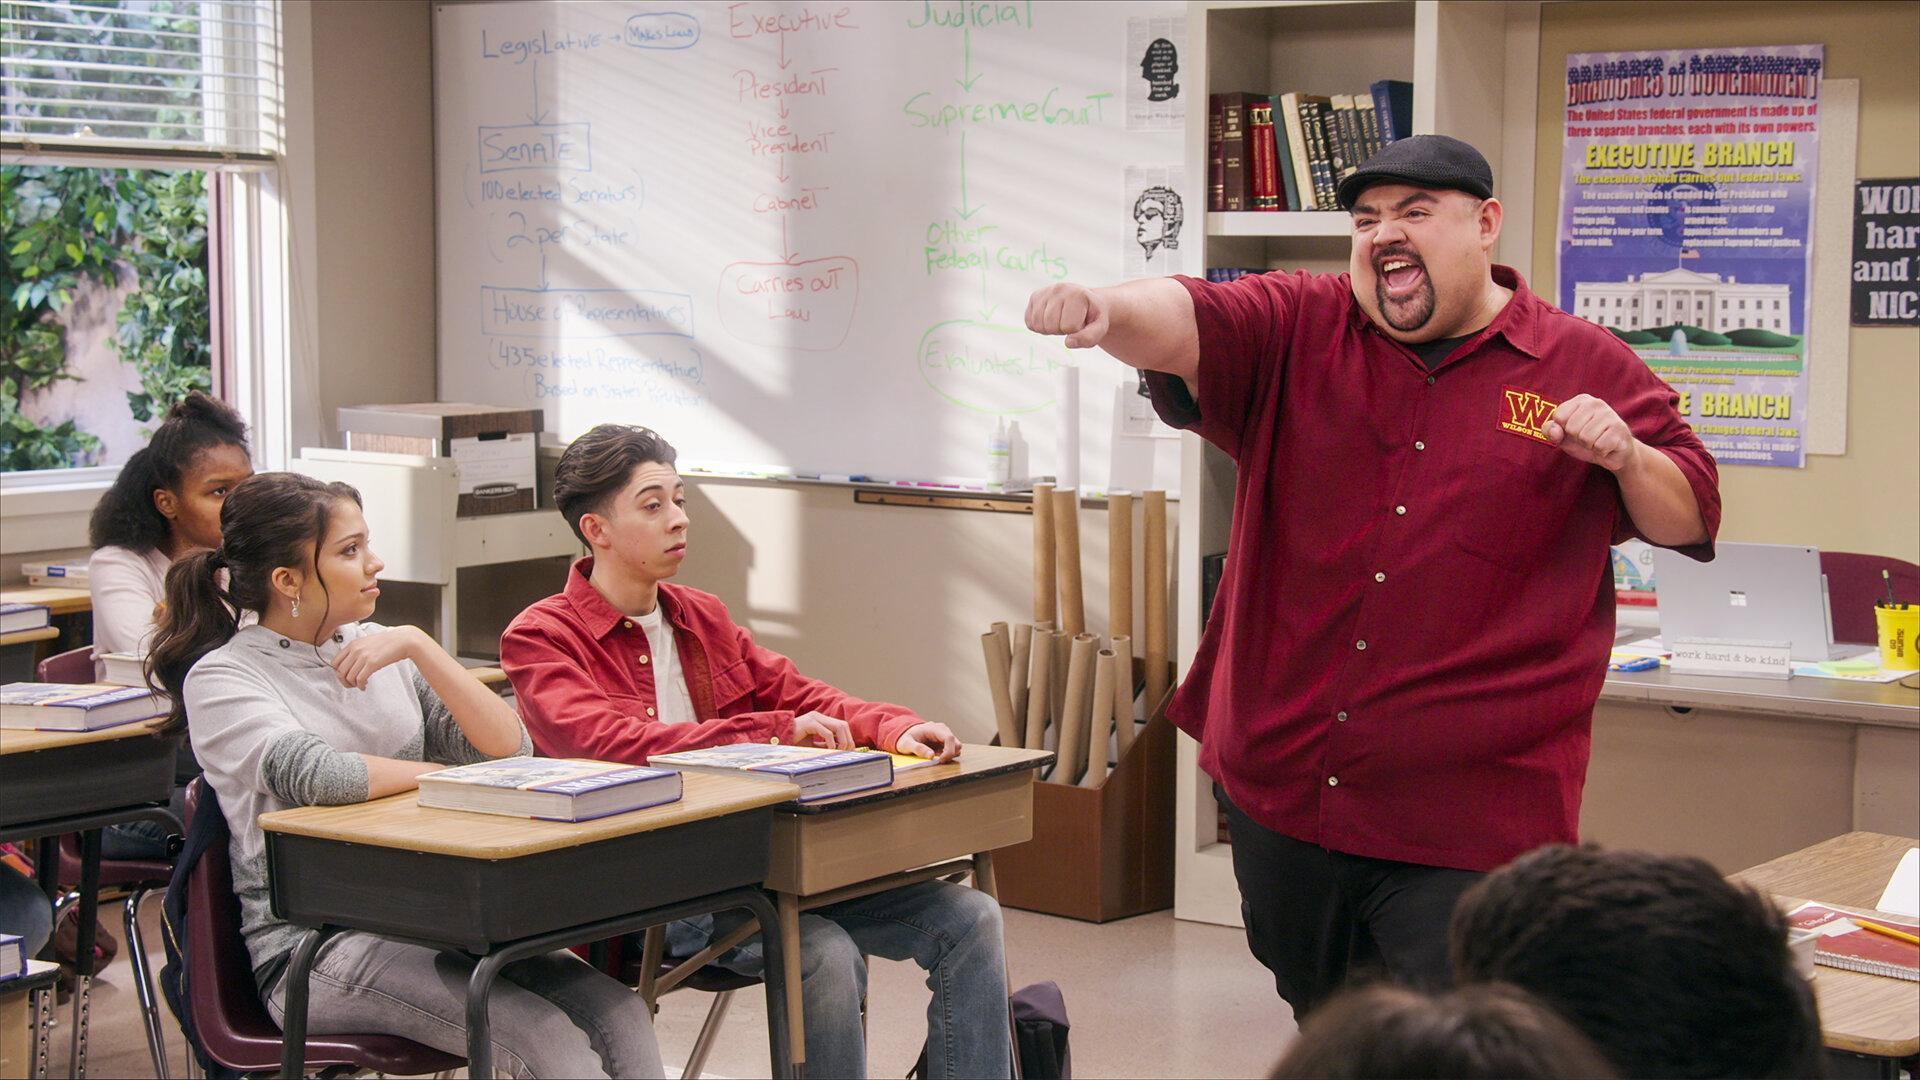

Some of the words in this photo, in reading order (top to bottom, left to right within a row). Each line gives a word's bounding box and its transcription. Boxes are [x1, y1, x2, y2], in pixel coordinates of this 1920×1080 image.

[728, 5, 859, 39] Executive
[906, 1, 1034, 30] Judicial
[1585, 144, 1695, 169] EXECUTIVE
[1703, 141, 1795, 168] BRANCH
[1853, 257, 1910, 282] and
[1700, 391, 1792, 419] BRANCH
[1675, 650, 1701, 660] work
[1705, 650, 1730, 662] hard
[1744, 654, 1757, 663] be
[1760, 655, 1786, 666] kind
